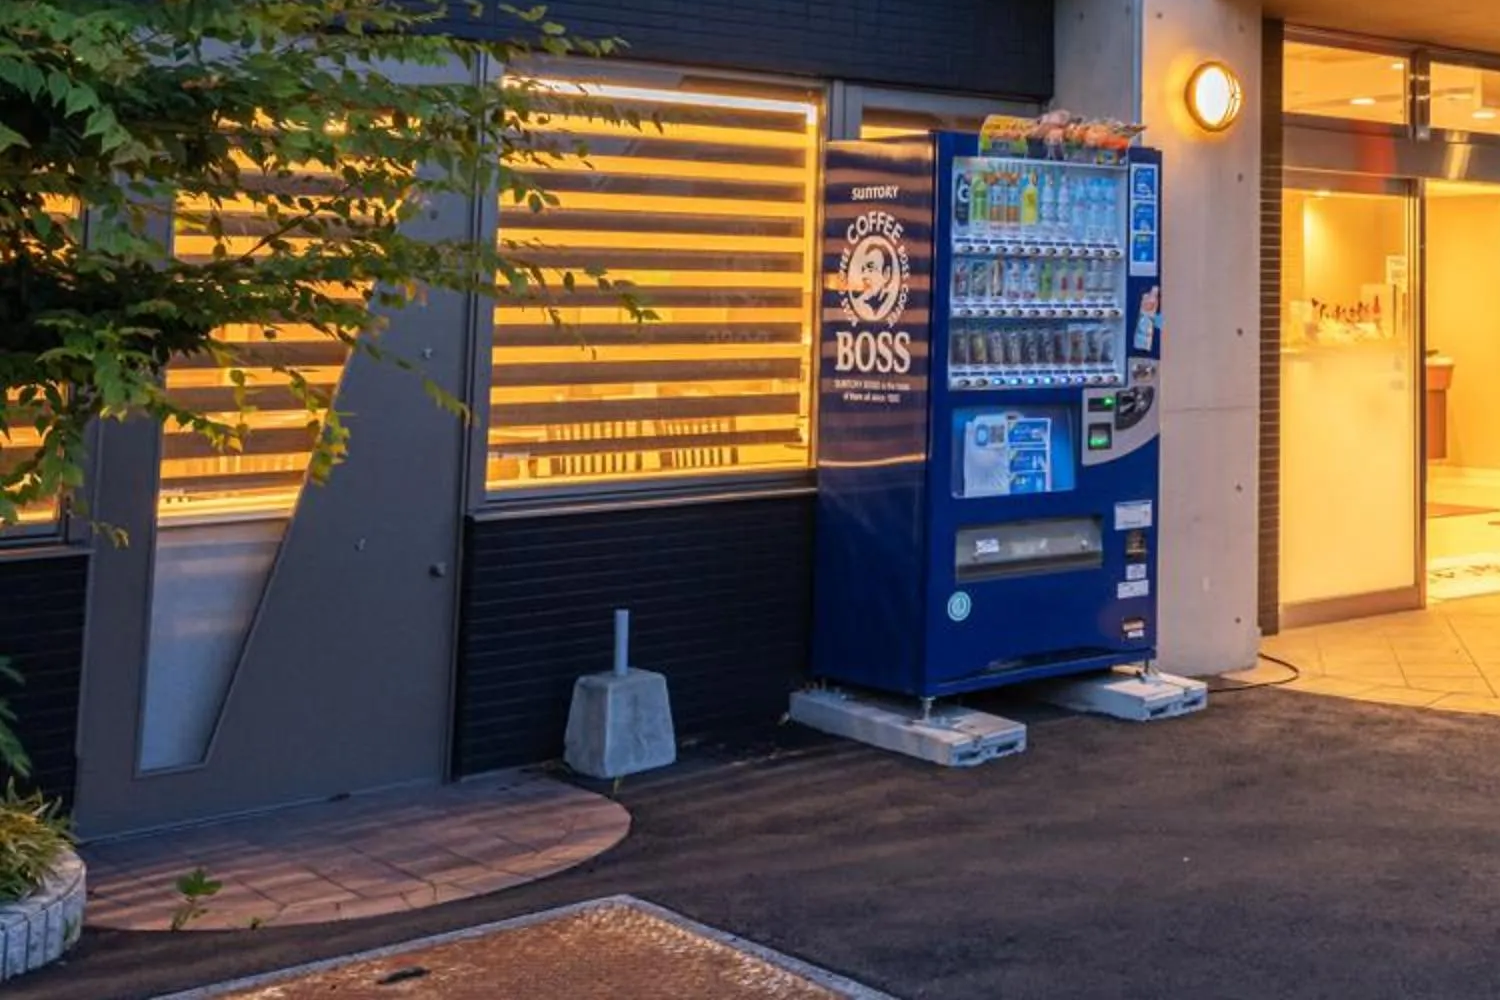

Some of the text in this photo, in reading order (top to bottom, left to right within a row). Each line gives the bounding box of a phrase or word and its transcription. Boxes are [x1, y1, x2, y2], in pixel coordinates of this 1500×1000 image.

[852, 185, 899, 200] SUNTORY
[847, 211, 904, 245] COFFEE
[835, 331, 911, 373] BOSS
